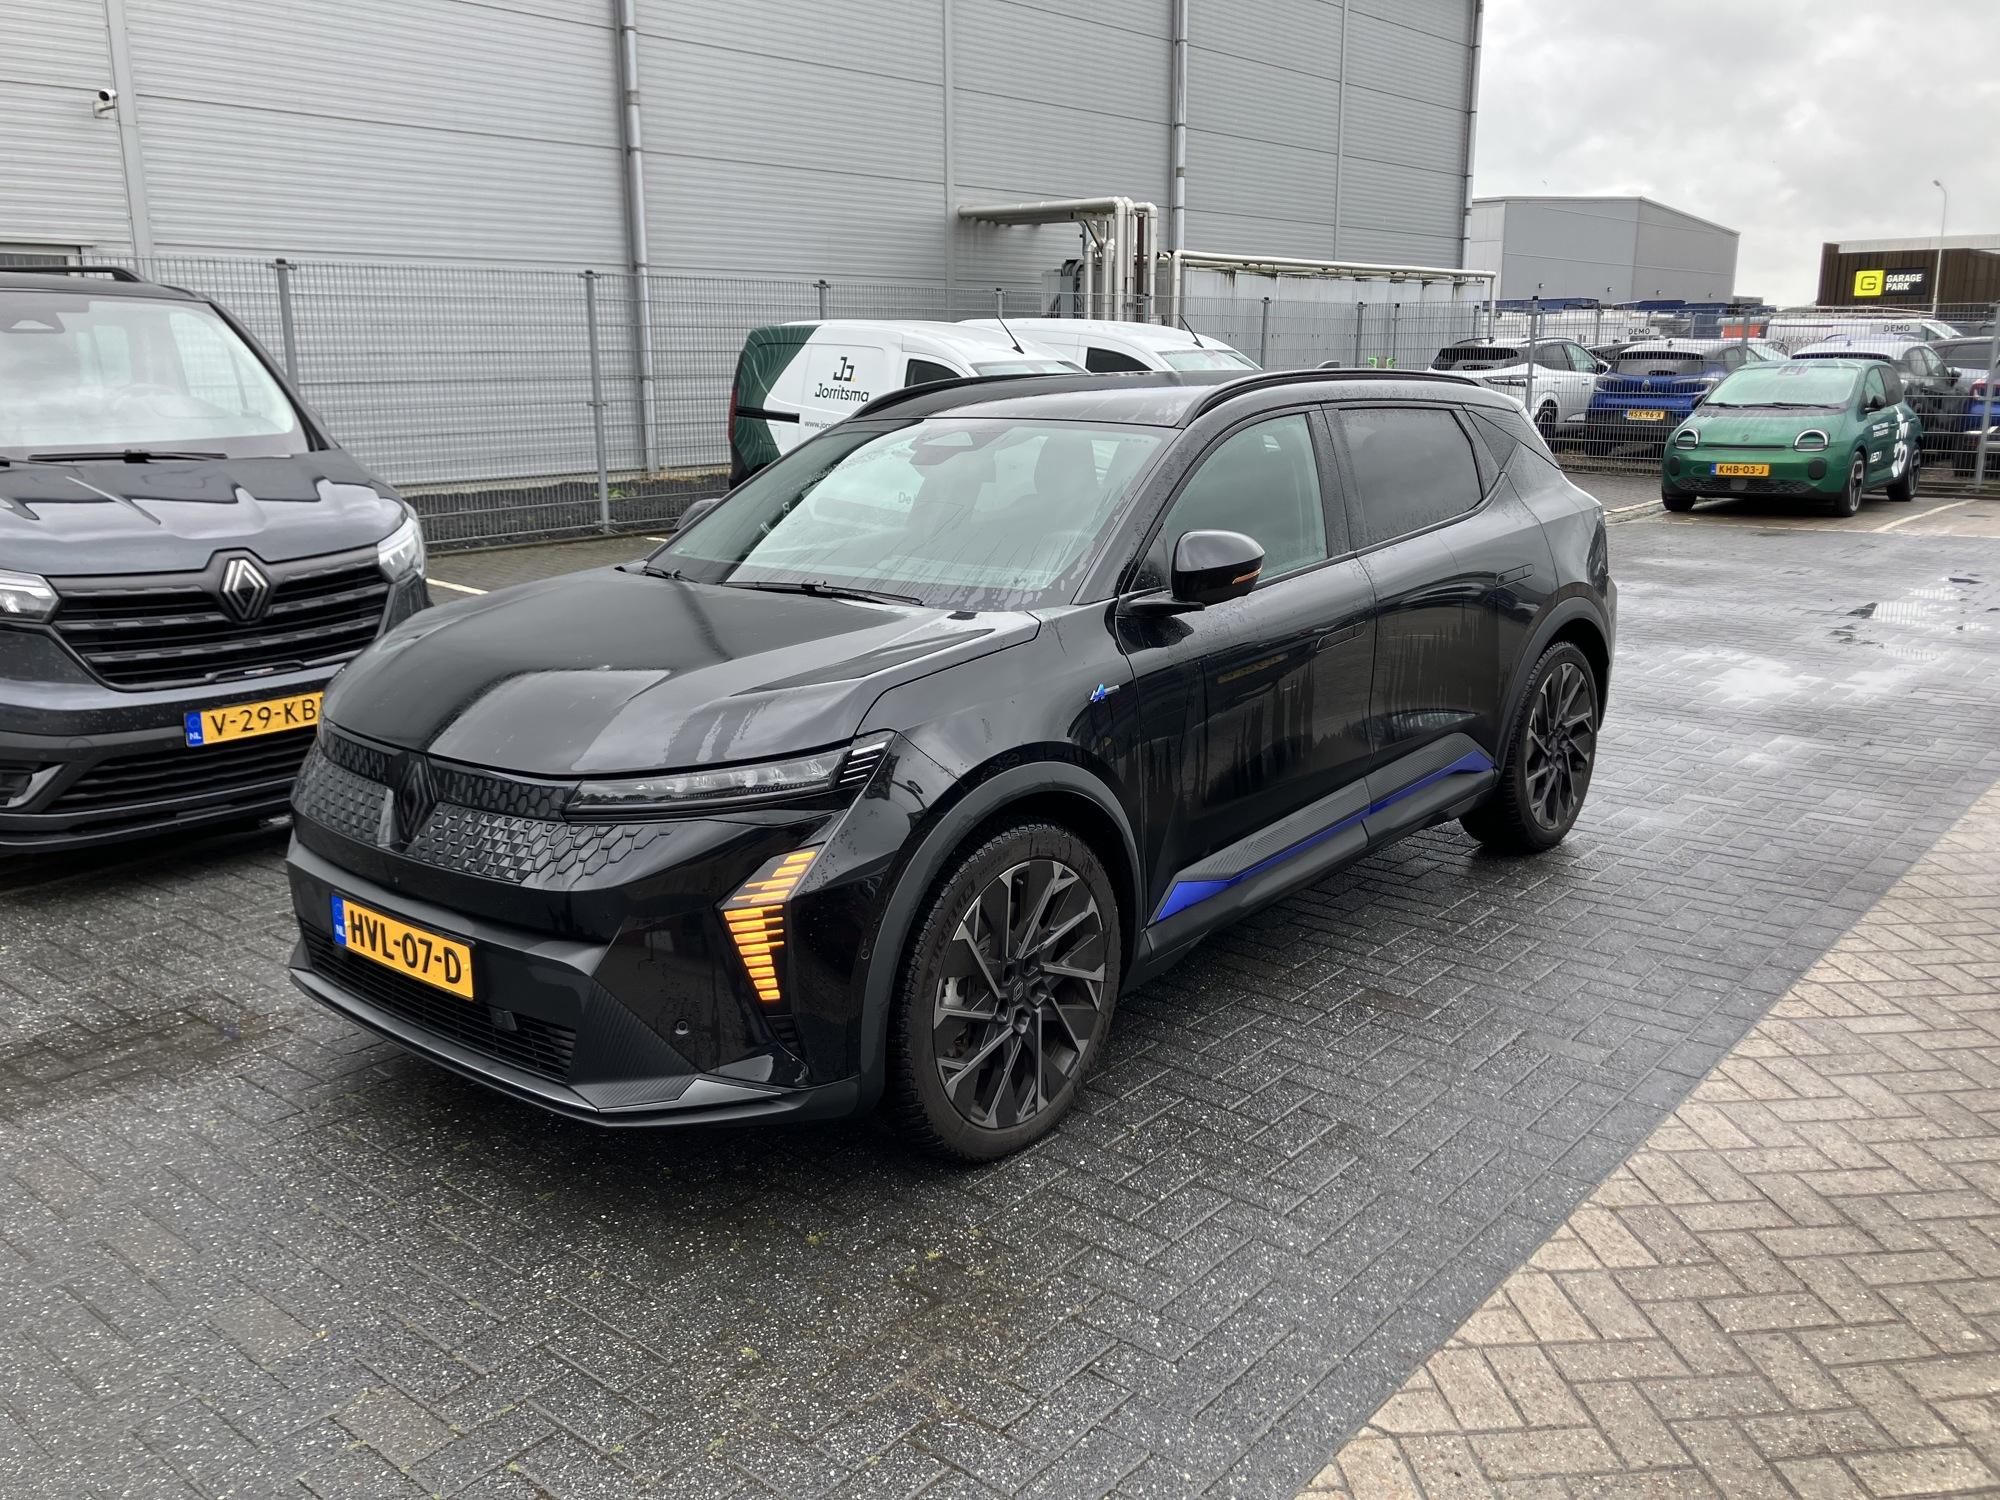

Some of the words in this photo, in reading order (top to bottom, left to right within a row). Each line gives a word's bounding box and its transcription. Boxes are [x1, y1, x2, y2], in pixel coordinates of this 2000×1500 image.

[1886, 273, 1923, 283] GARAGE
[1885, 282, 1910, 291] PARK
[1628, 327, 1651, 335] DEMO
[1883, 324, 1911, 332] DEMO
[815, 383, 870, 403] Jorritsma
[1718, 464, 1765, 475] KHB-03-J
[189, 732, 201, 740] NL
[210, 696, 323, 736] V-29-KB
[336, 924, 346, 937] NL
[349, 909, 462, 984] HVL-07-D
